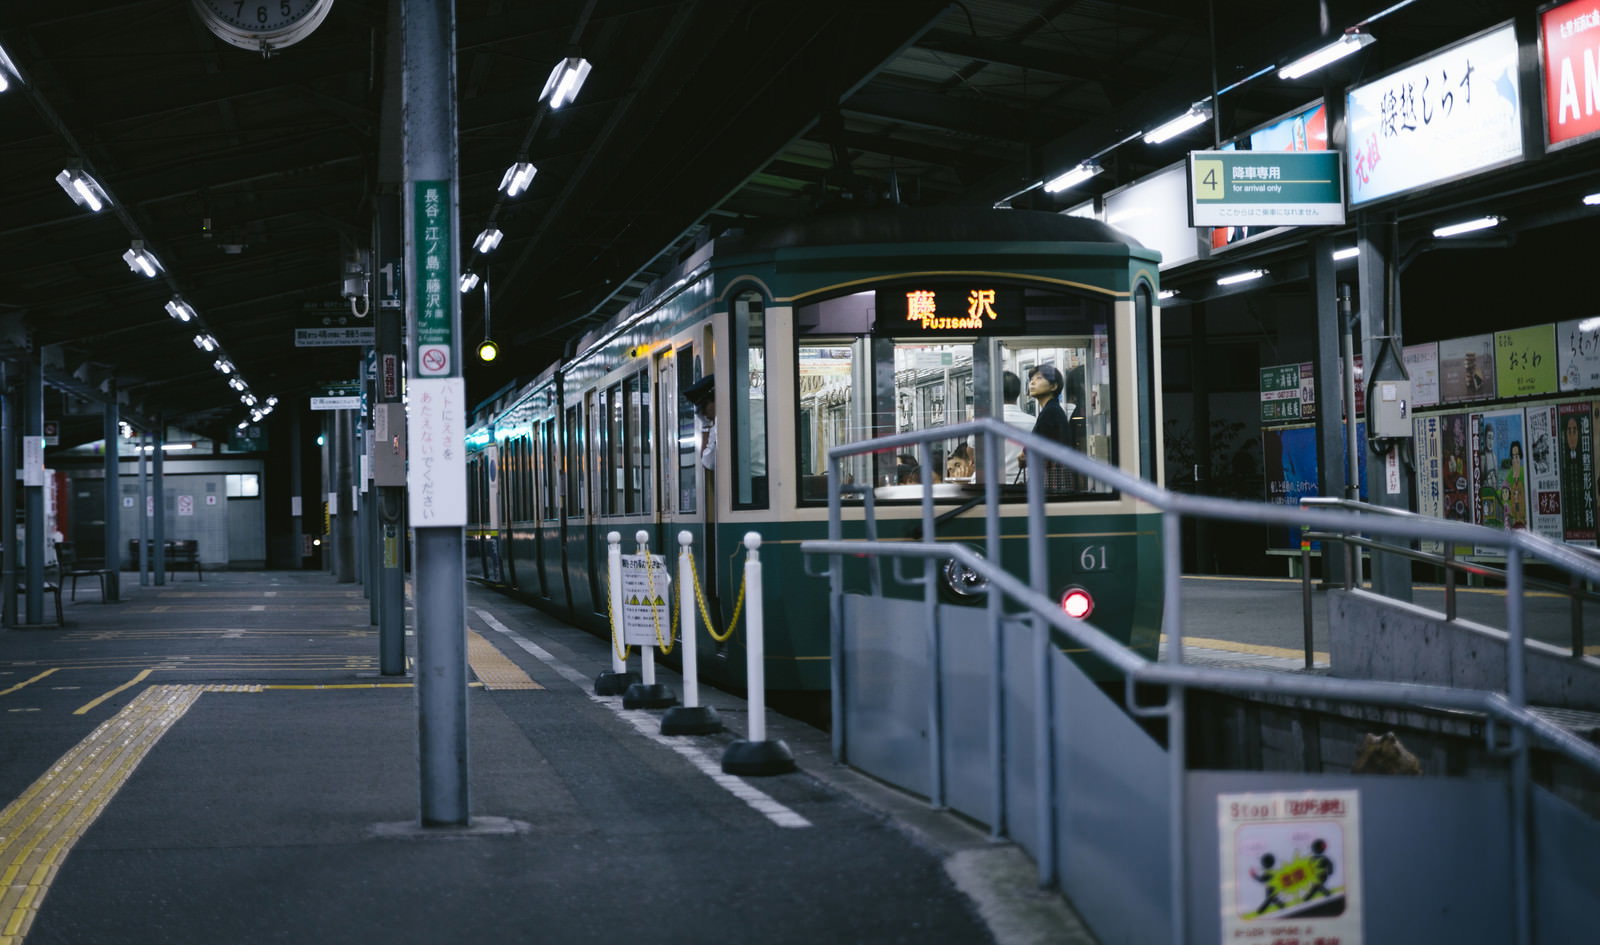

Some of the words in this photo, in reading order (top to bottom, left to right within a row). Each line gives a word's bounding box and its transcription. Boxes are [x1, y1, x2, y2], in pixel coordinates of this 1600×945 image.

[234, 1, 244, 17] 7
[257, 6, 268, 23] 6
[280, 0, 291, 16] 5
[1380, 58, 1475, 138] 腰越しらす
[1202, 168, 1218, 191] 4
[1232, 166, 1281, 180] 降車専用
[1232, 184, 1243, 192] for
[1244, 184, 1266, 192] arrival
[1267, 184, 1282, 194] only
[424, 188, 441, 308] 長谷・江ノ島・藤沢
[905, 289, 998, 320] 藤沢
[921, 317, 983, 329] FUJISAWA
[1580, 415, 1594, 528] 池田整形外科
[1080, 544, 1109, 570] 61
